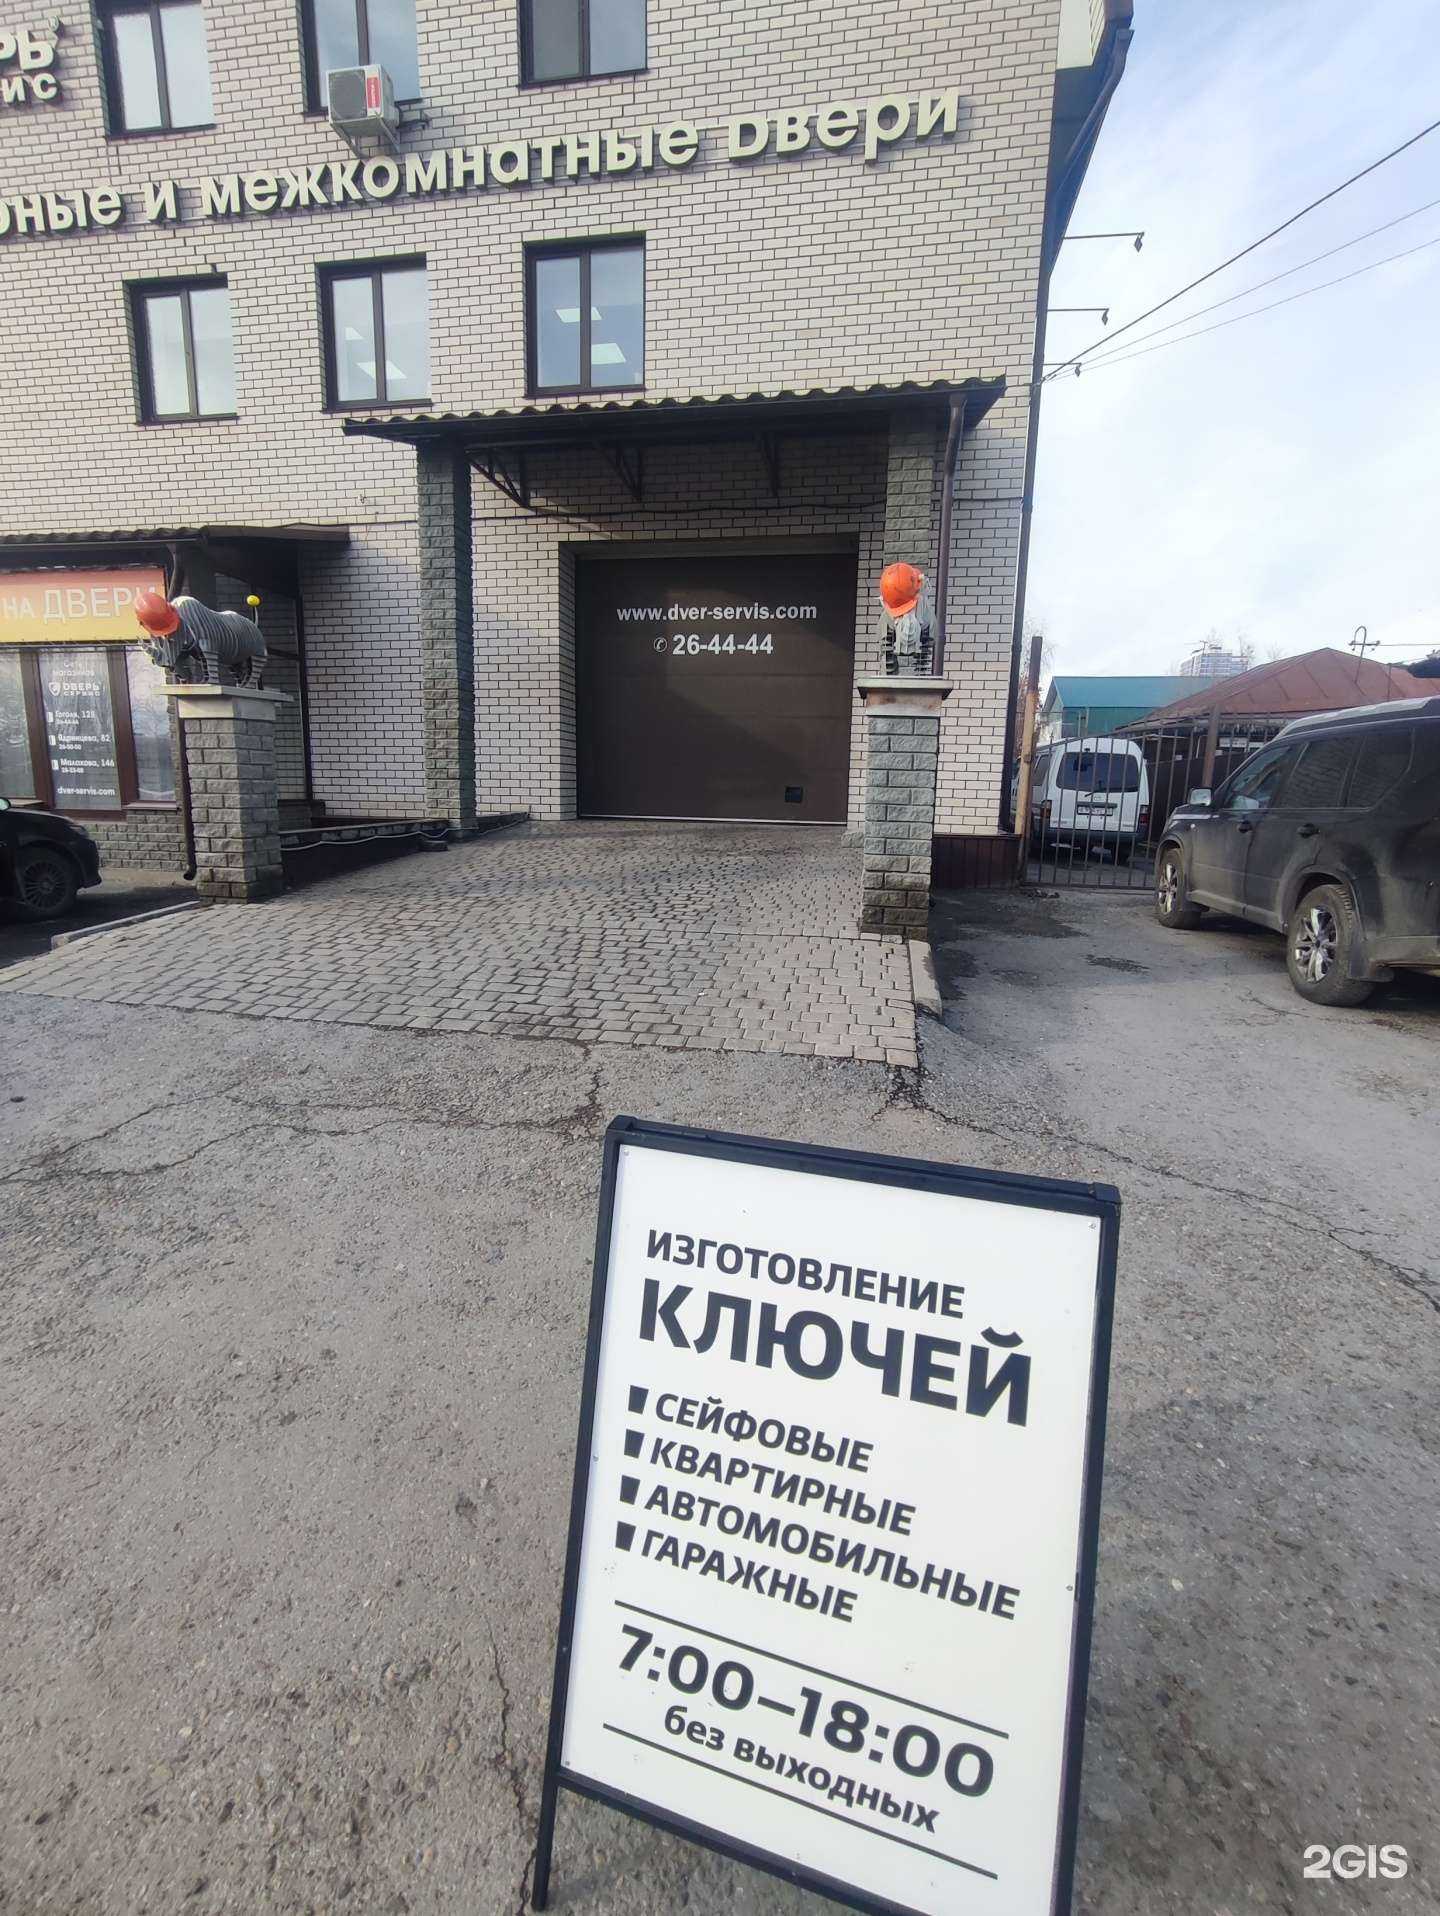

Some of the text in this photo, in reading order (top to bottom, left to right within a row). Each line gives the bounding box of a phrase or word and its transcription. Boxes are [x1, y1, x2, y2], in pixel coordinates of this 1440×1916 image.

[200, 120, 699, 216] межкомнатные
[616, 602, 817, 621] www.dver-servis.com
[672, 633, 774, 655] 26-44-44
[647, 1229, 965, 1319] ИЗГОТОВЛЕНИЕ
[639, 1277, 1031, 1427] КЛЮЧЕЙ
[655, 1392, 874, 1473] СЕЙФОВЫЕ
[649, 1437, 916, 1537] КВАРТИРНЫЕ
[641, 1529, 859, 1623] ГАРАЖНЫЕ
[644, 1484, 1021, 1621] АВТОМОБИЛЬНЫЕ
[664, 1705, 939, 1834] без выходных
